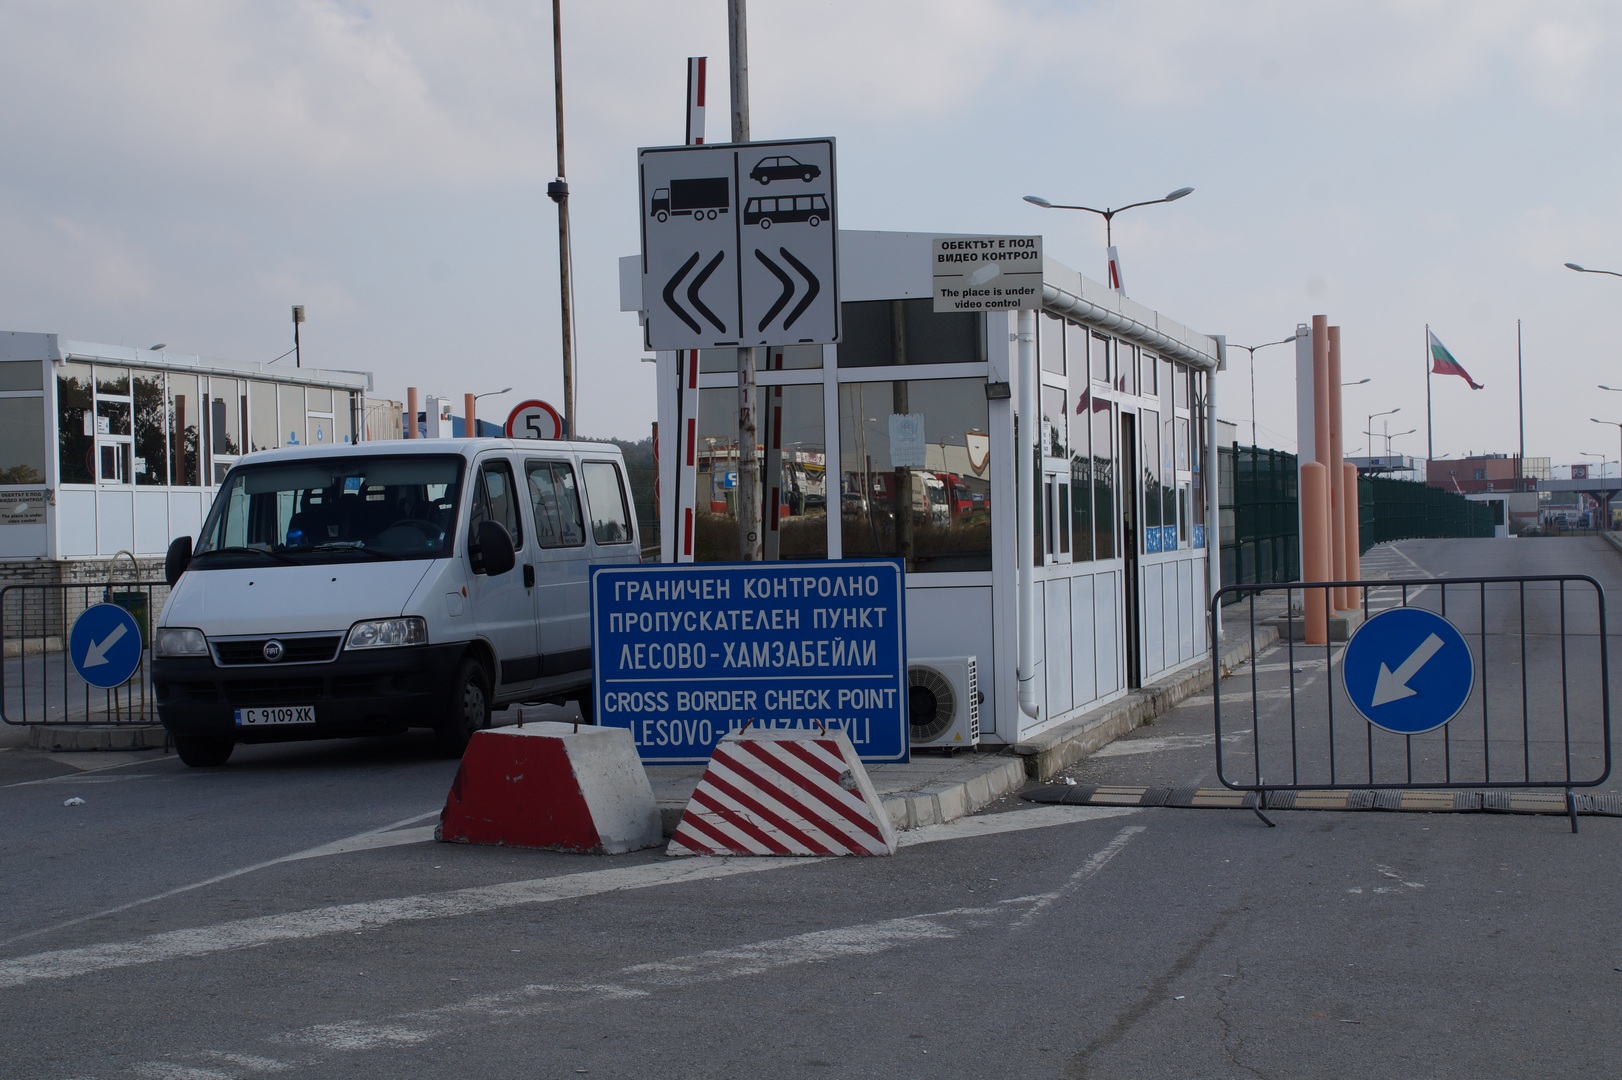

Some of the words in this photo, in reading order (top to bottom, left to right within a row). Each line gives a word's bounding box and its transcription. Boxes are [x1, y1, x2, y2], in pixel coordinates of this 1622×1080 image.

[941, 240, 995, 250] ОБЕКТЪТ
[999, 240, 1005, 248] Е
[1009, 239, 1034, 249] ПОД
[938, 253, 978, 263] ВИДЕО
[982, 251, 1038, 261] КОНТРОЛ
[941, 289, 959, 297] The
[962, 288, 990, 298] place
[1005, 287, 1035, 295] under
[955, 300, 982, 308] video
[985, 299, 1021, 307] control
[526, 415, 541, 438] 5
[614, 578, 730, 601] ГРАНИЧЕН
[744, 575, 879, 599] КОНТРОЛНО
[610, 609, 800, 633] ПРОПУСКАТЕЛЕН
[814, 607, 887, 629] ПУНКТ
[266, 647, 279, 655] FIAT
[619, 637, 877, 670] ЛЕСОВО-ХАМЗАБЕЙЛИ
[605, 691, 669, 712] CROSS
[677, 690, 757, 711] BORDER
[765, 689, 831, 710] CHECK
[838, 688, 897, 709] POINT
[247, 710, 256, 723] C
[262, 709, 293, 722] 9109
[296, 708, 312, 721] XK
